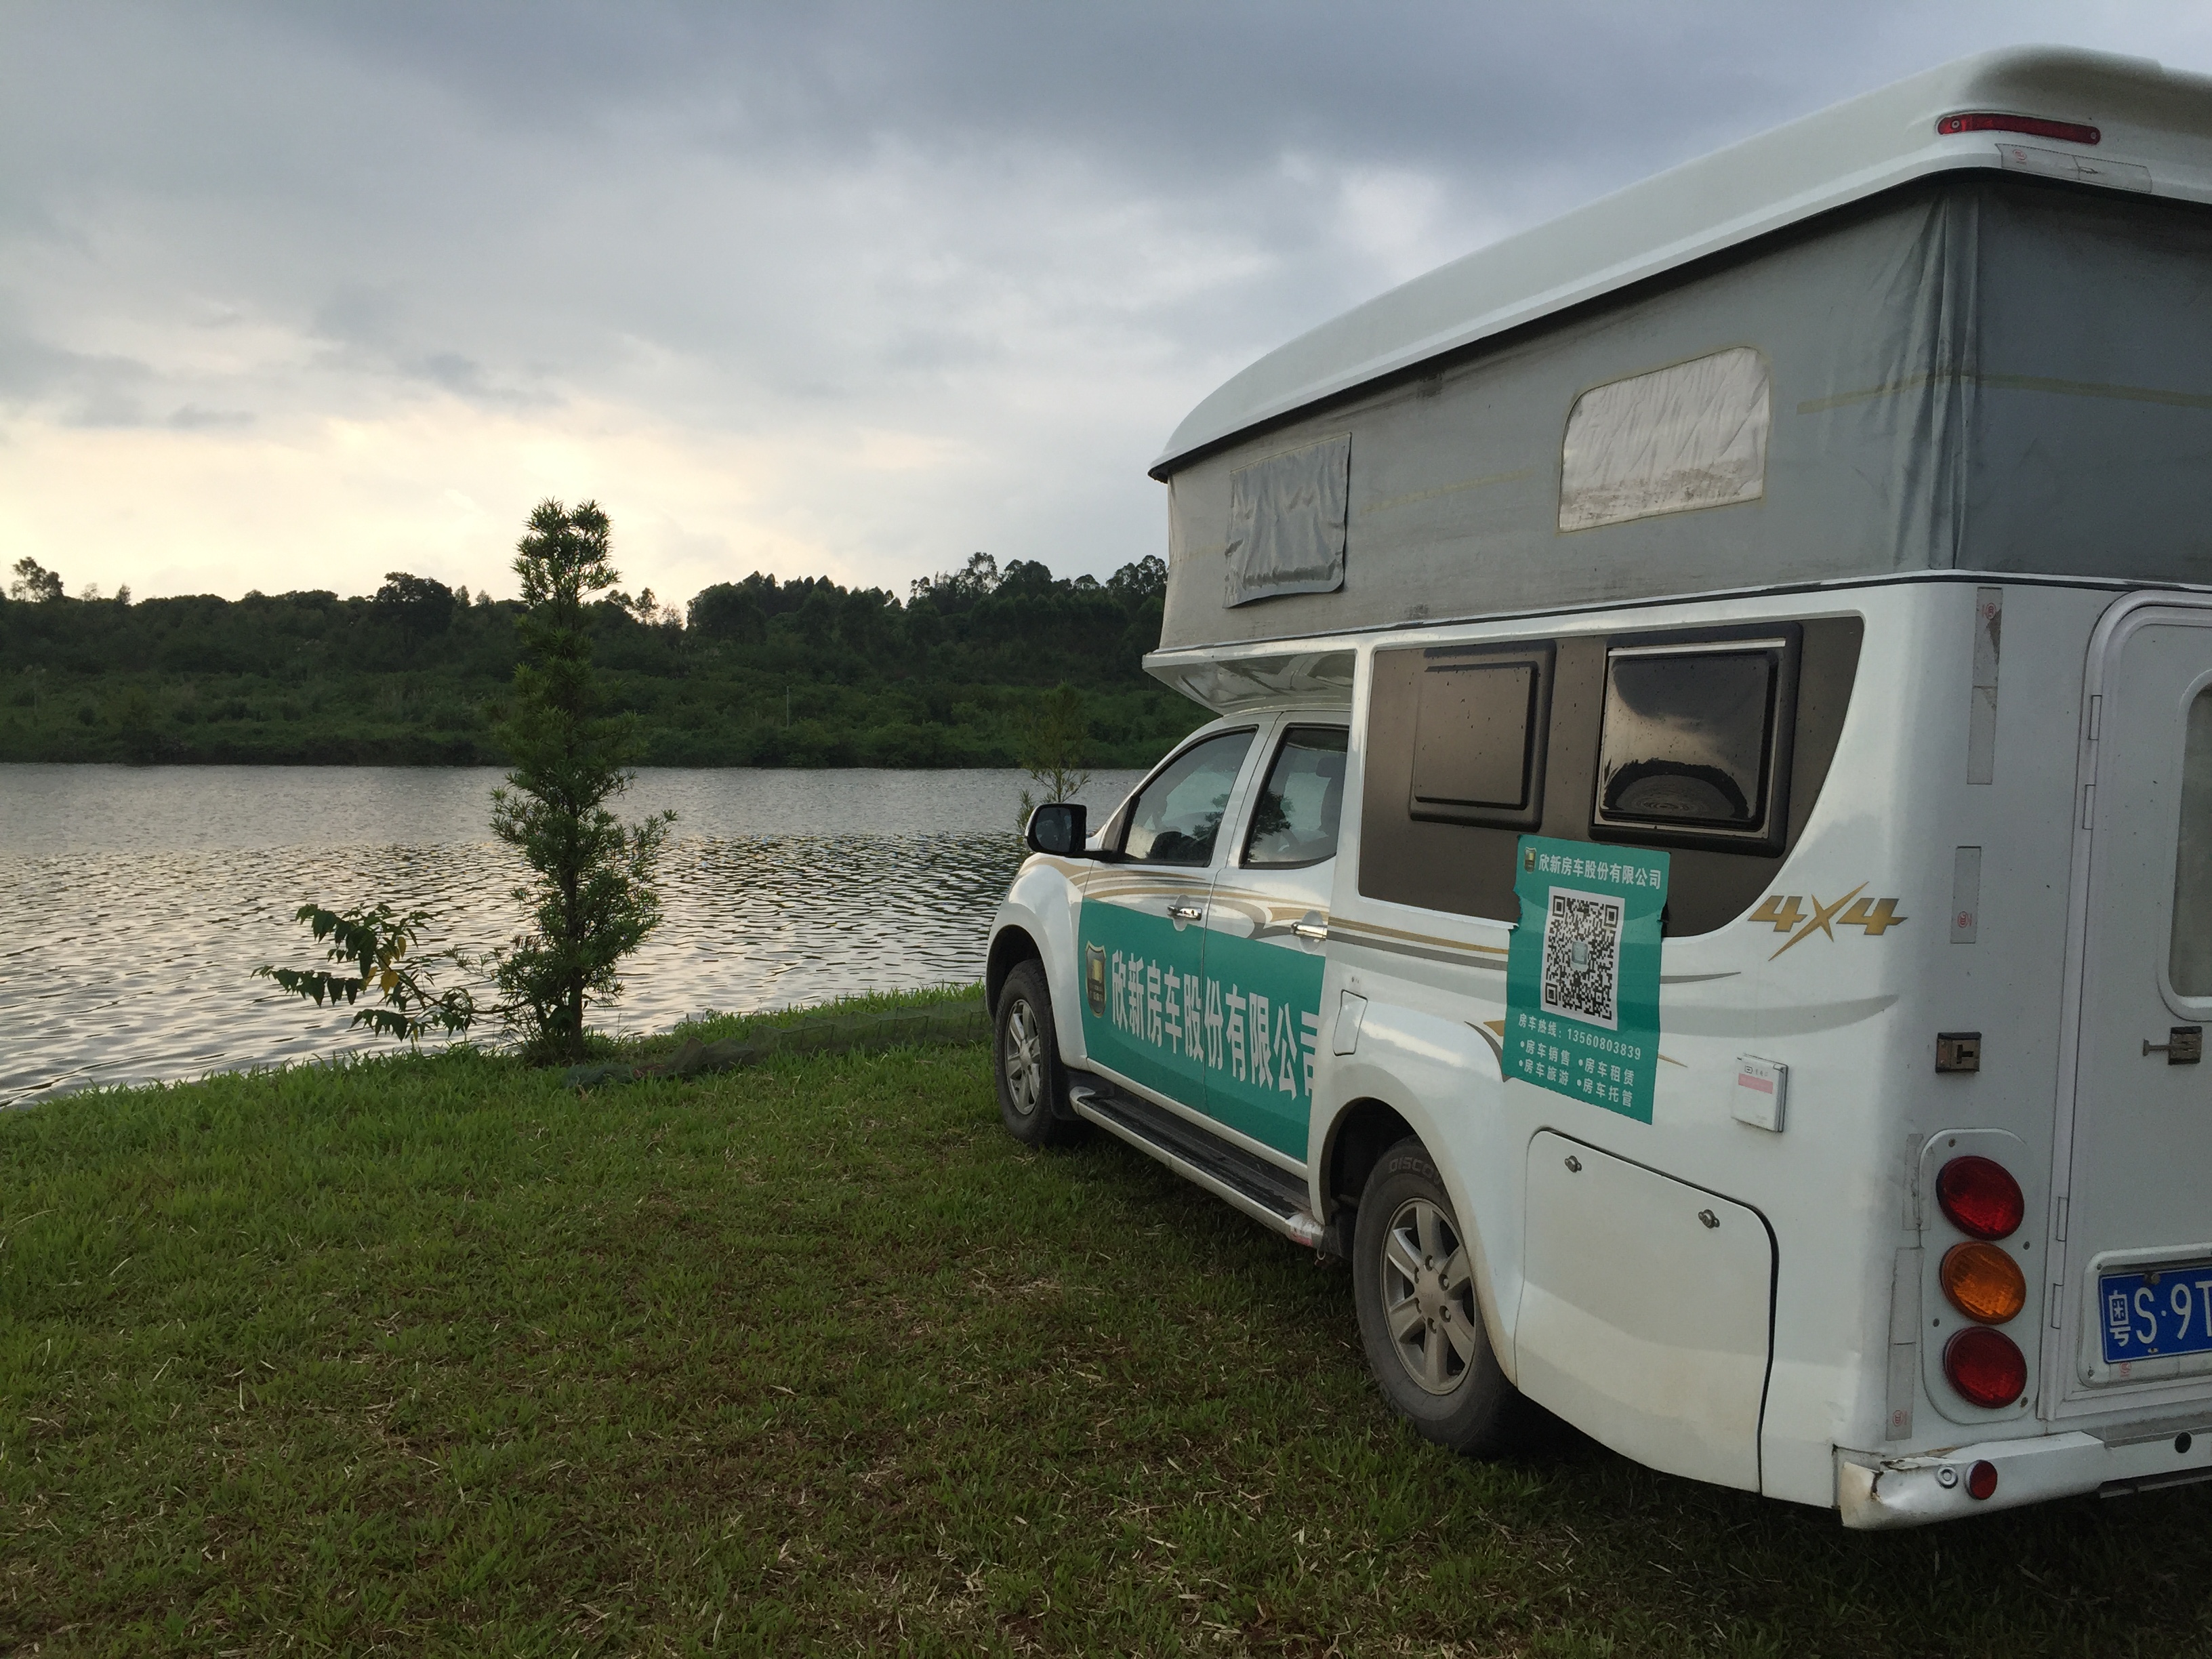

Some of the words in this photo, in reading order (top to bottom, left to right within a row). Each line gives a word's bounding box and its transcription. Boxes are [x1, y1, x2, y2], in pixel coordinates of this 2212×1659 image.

[1538, 854, 1661, 889] 欣新房车股份有限公司
[1524, 1059, 1570, 1086] 房车旅游
[1582, 1078, 1633, 1107] 房车托管
[1525, 1040, 1570, 1067] 房车销售
[1584, 1057, 1634, 1086] 房车租赁
